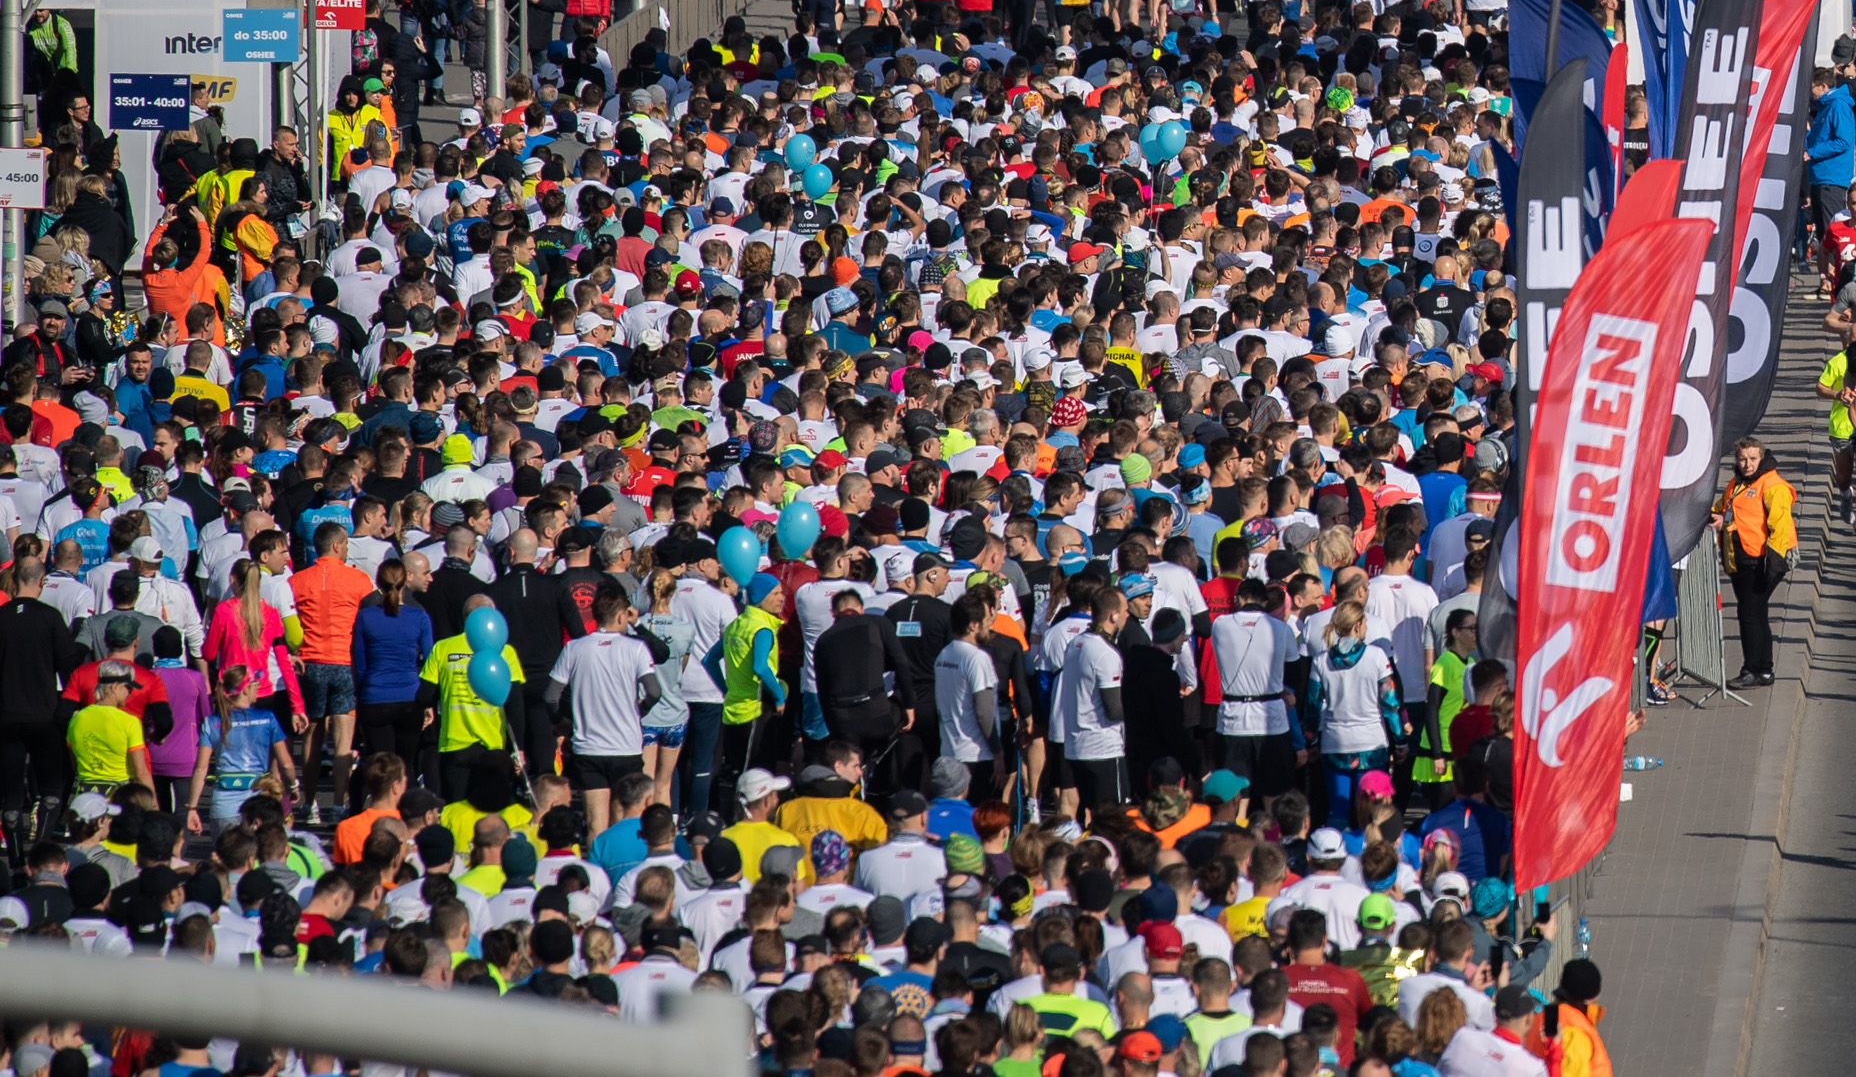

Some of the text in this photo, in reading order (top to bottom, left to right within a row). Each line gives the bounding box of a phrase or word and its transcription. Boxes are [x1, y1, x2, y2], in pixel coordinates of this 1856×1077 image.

[234, 30, 288, 40] do 35:00
[246, 51, 276, 59] OSHEE
[115, 97, 145, 106] 35:01
[153, 98, 186, 108] 40:00
[6, 172, 39, 182] 45:00
[1561, 333, 1642, 573] ORLEN
